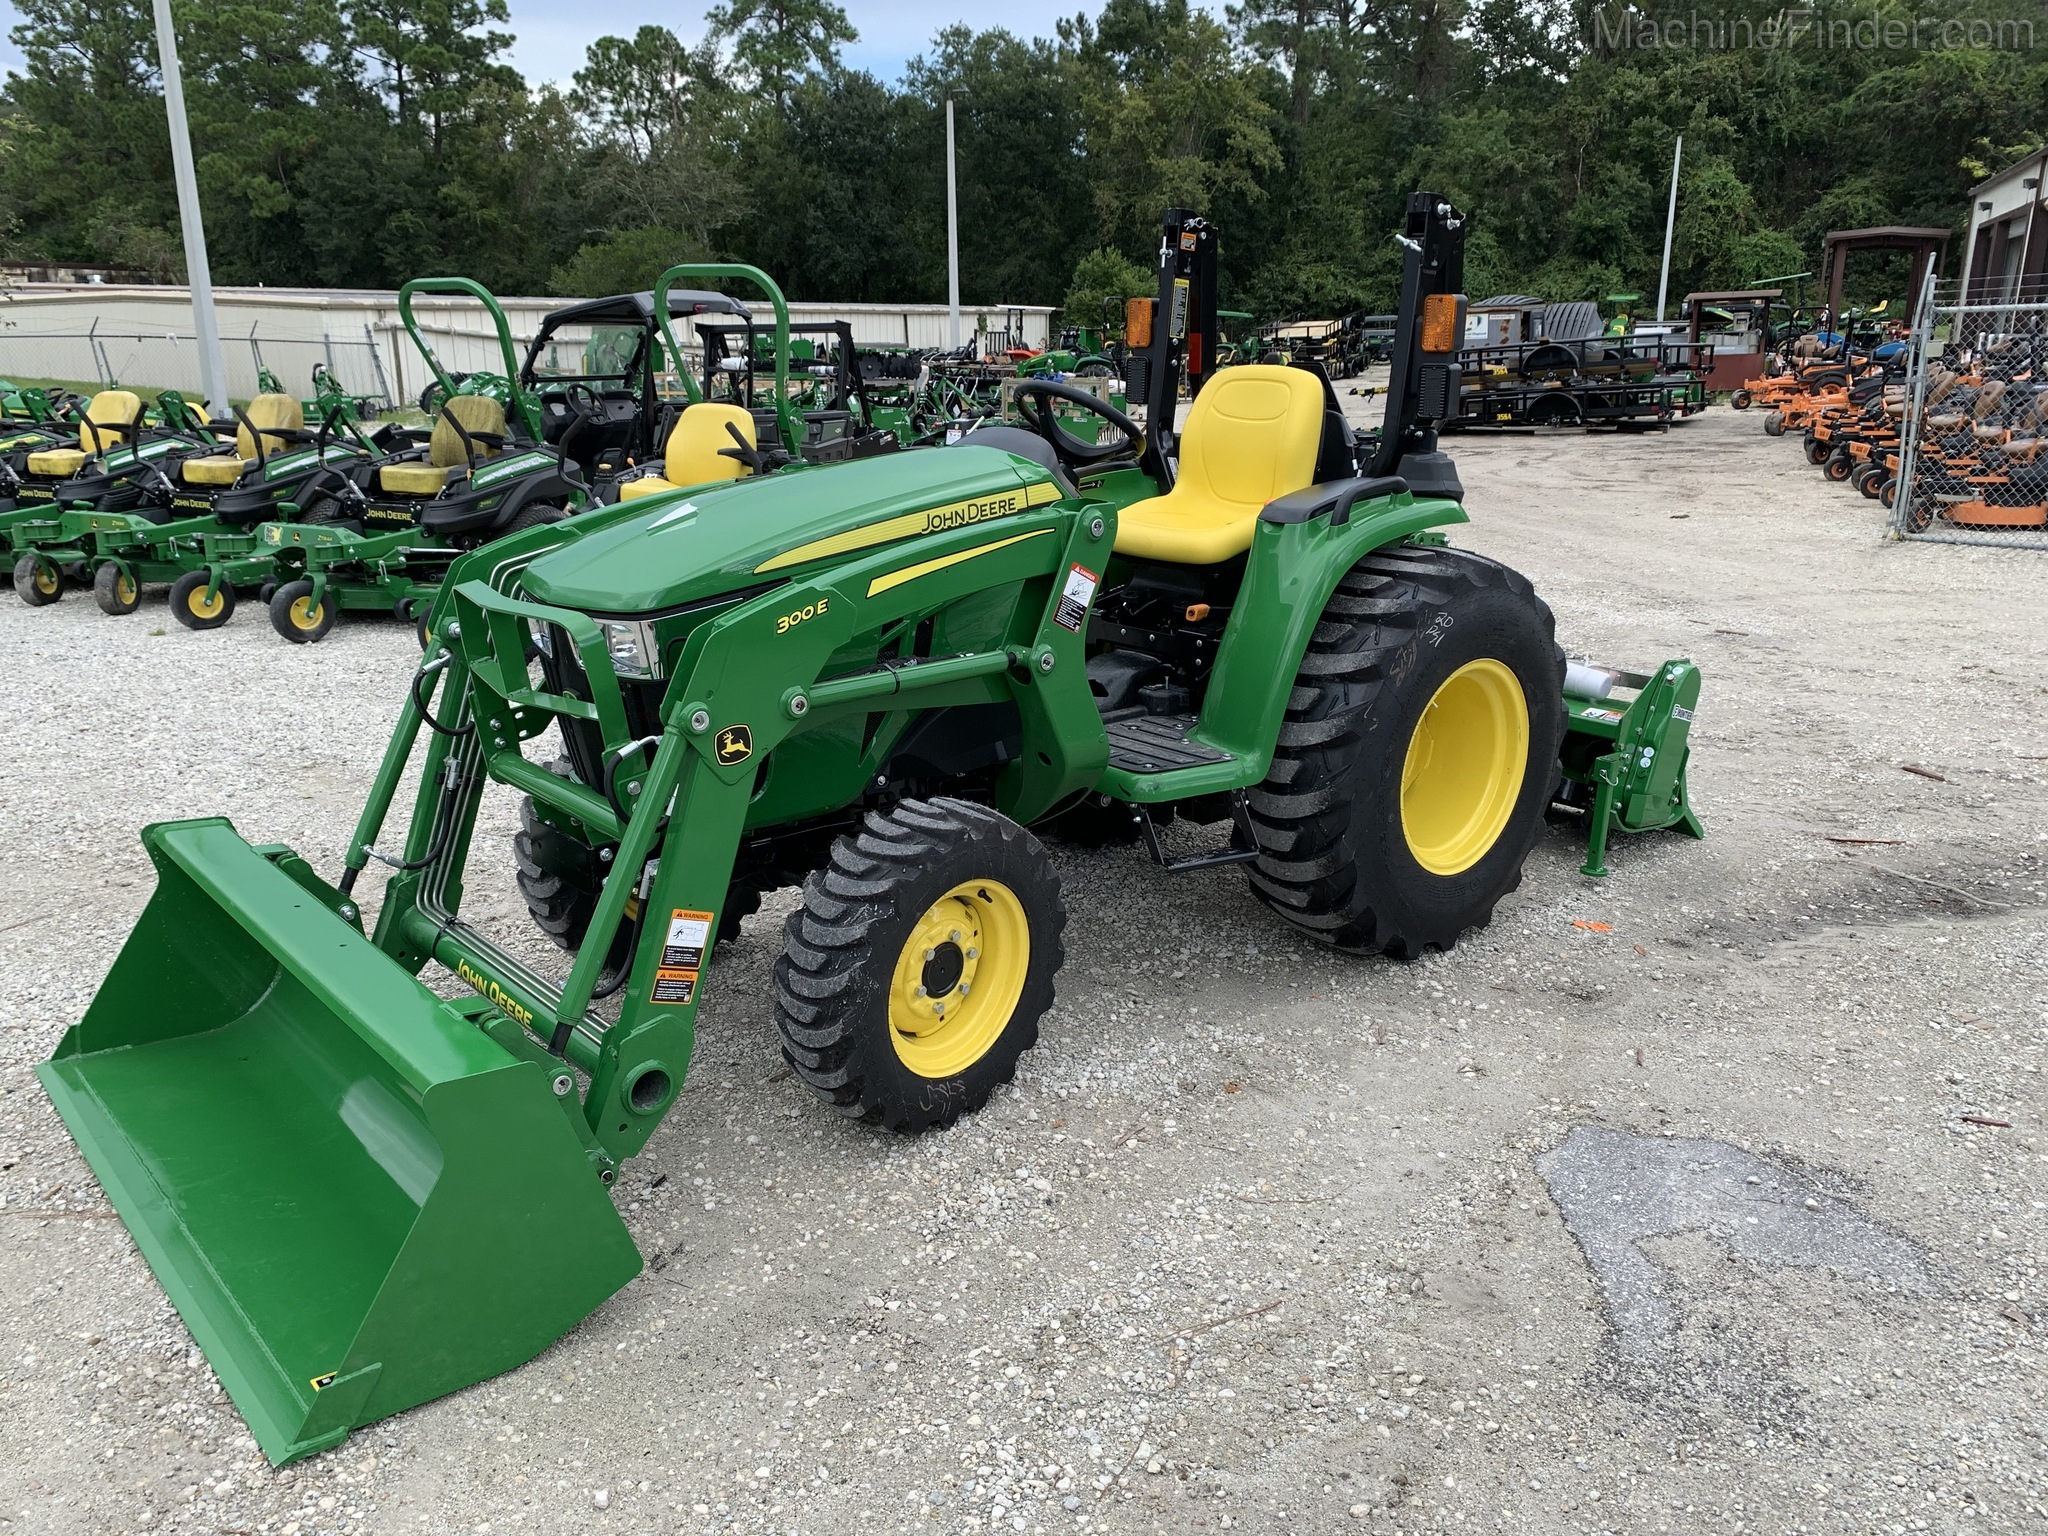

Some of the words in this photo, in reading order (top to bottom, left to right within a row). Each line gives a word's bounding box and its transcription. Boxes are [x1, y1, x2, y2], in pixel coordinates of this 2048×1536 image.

[18, 488, 34, 498] JOHN
[172, 498, 190, 508] JOHN
[190, 499, 212, 509] DEERE
[366, 508, 387, 519] JOHN
[387, 510, 412, 521] DEERE
[922, 508, 966, 532] JOHN
[967, 497, 1017, 521] DEERE
[1079, 568, 1096, 581] DANGER
[683, 912, 709, 920] WARNING
[455, 958, 488, 995] JOHN
[489, 981, 534, 1031] DEERE
